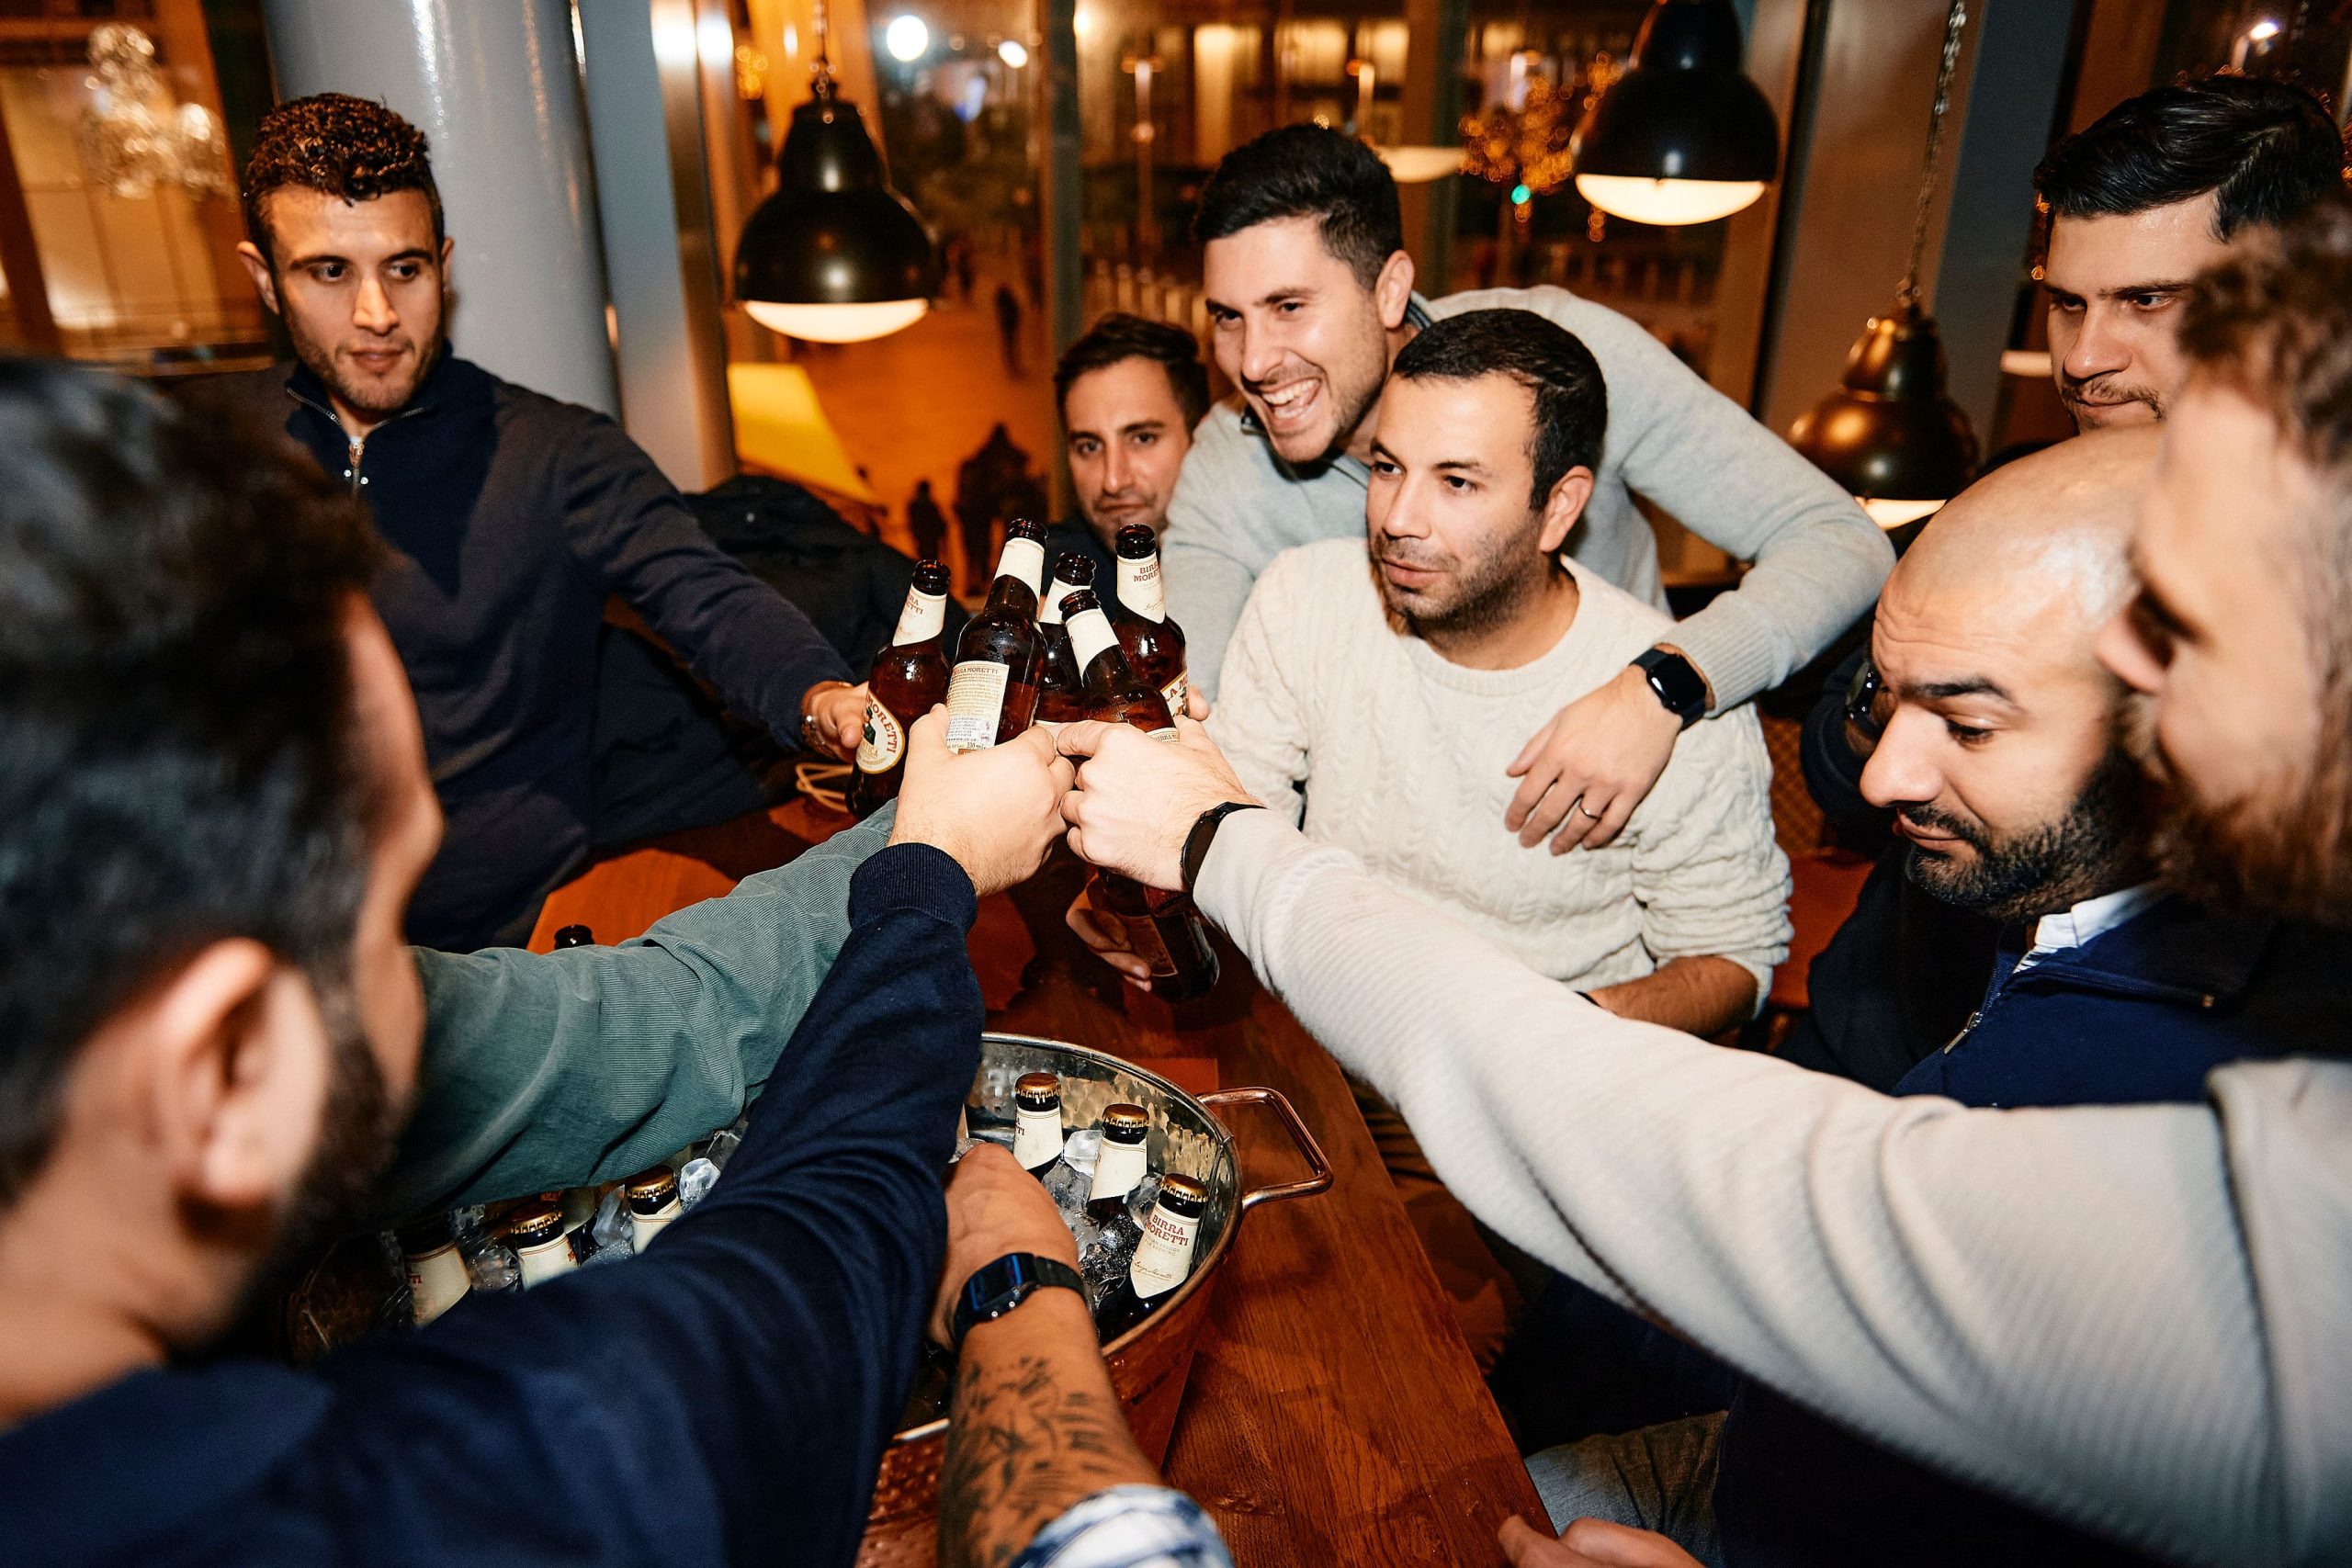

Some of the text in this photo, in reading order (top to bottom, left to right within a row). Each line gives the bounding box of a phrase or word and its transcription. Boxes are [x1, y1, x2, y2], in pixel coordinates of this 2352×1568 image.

[967, 667, 999, 675] MORETTI
[1146, 1221, 1189, 1247] MORETTI
[1152, 1214, 1184, 1235] BIRRA
